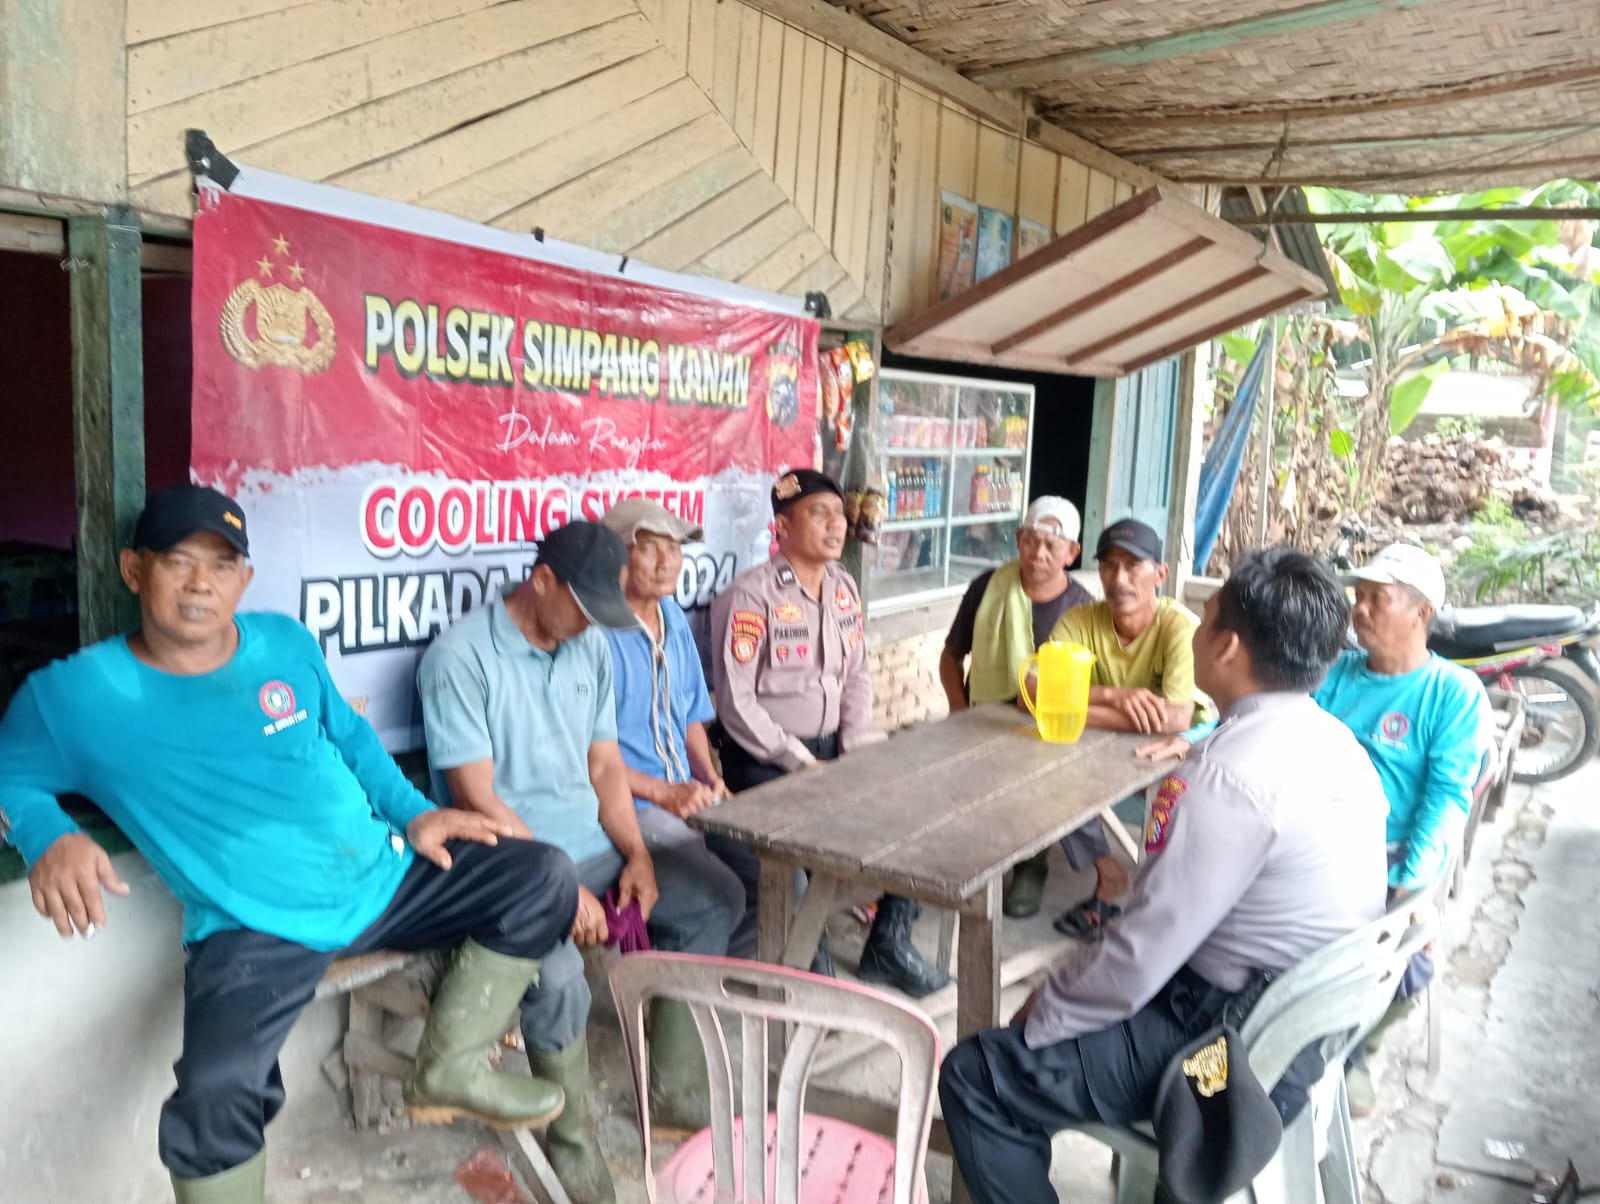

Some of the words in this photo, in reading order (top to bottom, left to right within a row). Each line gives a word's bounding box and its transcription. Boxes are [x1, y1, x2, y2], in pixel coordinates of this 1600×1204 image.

[364, 293, 515, 386] POLSEK
[522, 319, 661, 398] SIMPANG
[667, 342, 752, 407] KANAN
[496, 404, 580, 454] Dalam
[581, 415, 666, 470] Rangka
[364, 486, 568, 548] COOLING
[581, 488, 705, 525] SEM
[676, 553, 736, 609] 024
